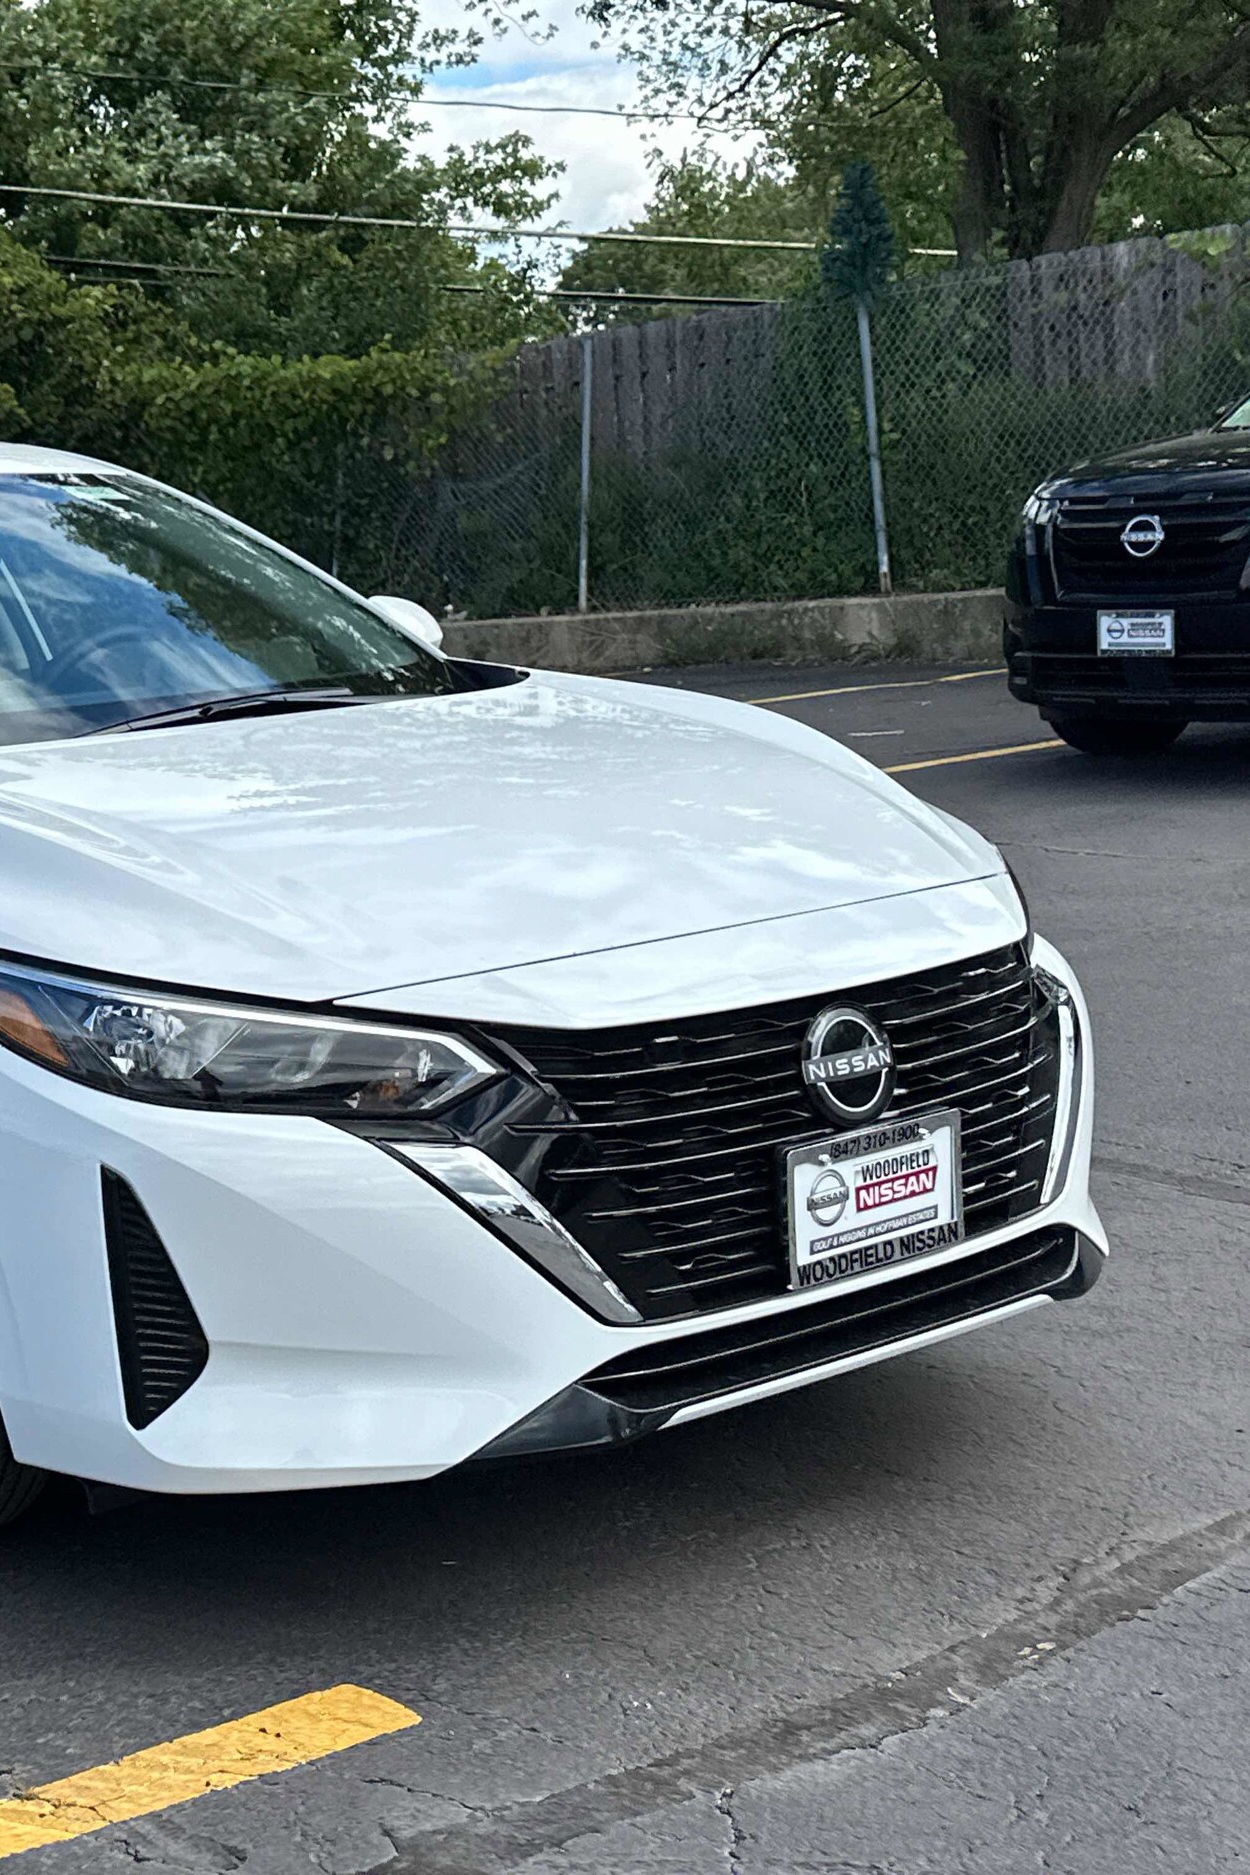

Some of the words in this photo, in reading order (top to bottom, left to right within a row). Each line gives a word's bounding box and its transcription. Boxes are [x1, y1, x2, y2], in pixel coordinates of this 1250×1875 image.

[808, 1048, 891, 1080] NISSAN
[830, 1137, 860, 1159] (847)
[863, 1123, 919, 1151] 310-1900
[861, 1149, 930, 1183] WOODFIELD
[810, 1189, 847, 1206] NISSAN
[859, 1172, 934, 1208] NISSAN
[875, 1218, 908, 1234] HOFFMAN
[797, 1241, 894, 1287] WOODFIELD
[900, 1223, 958, 1256] NISSAN
